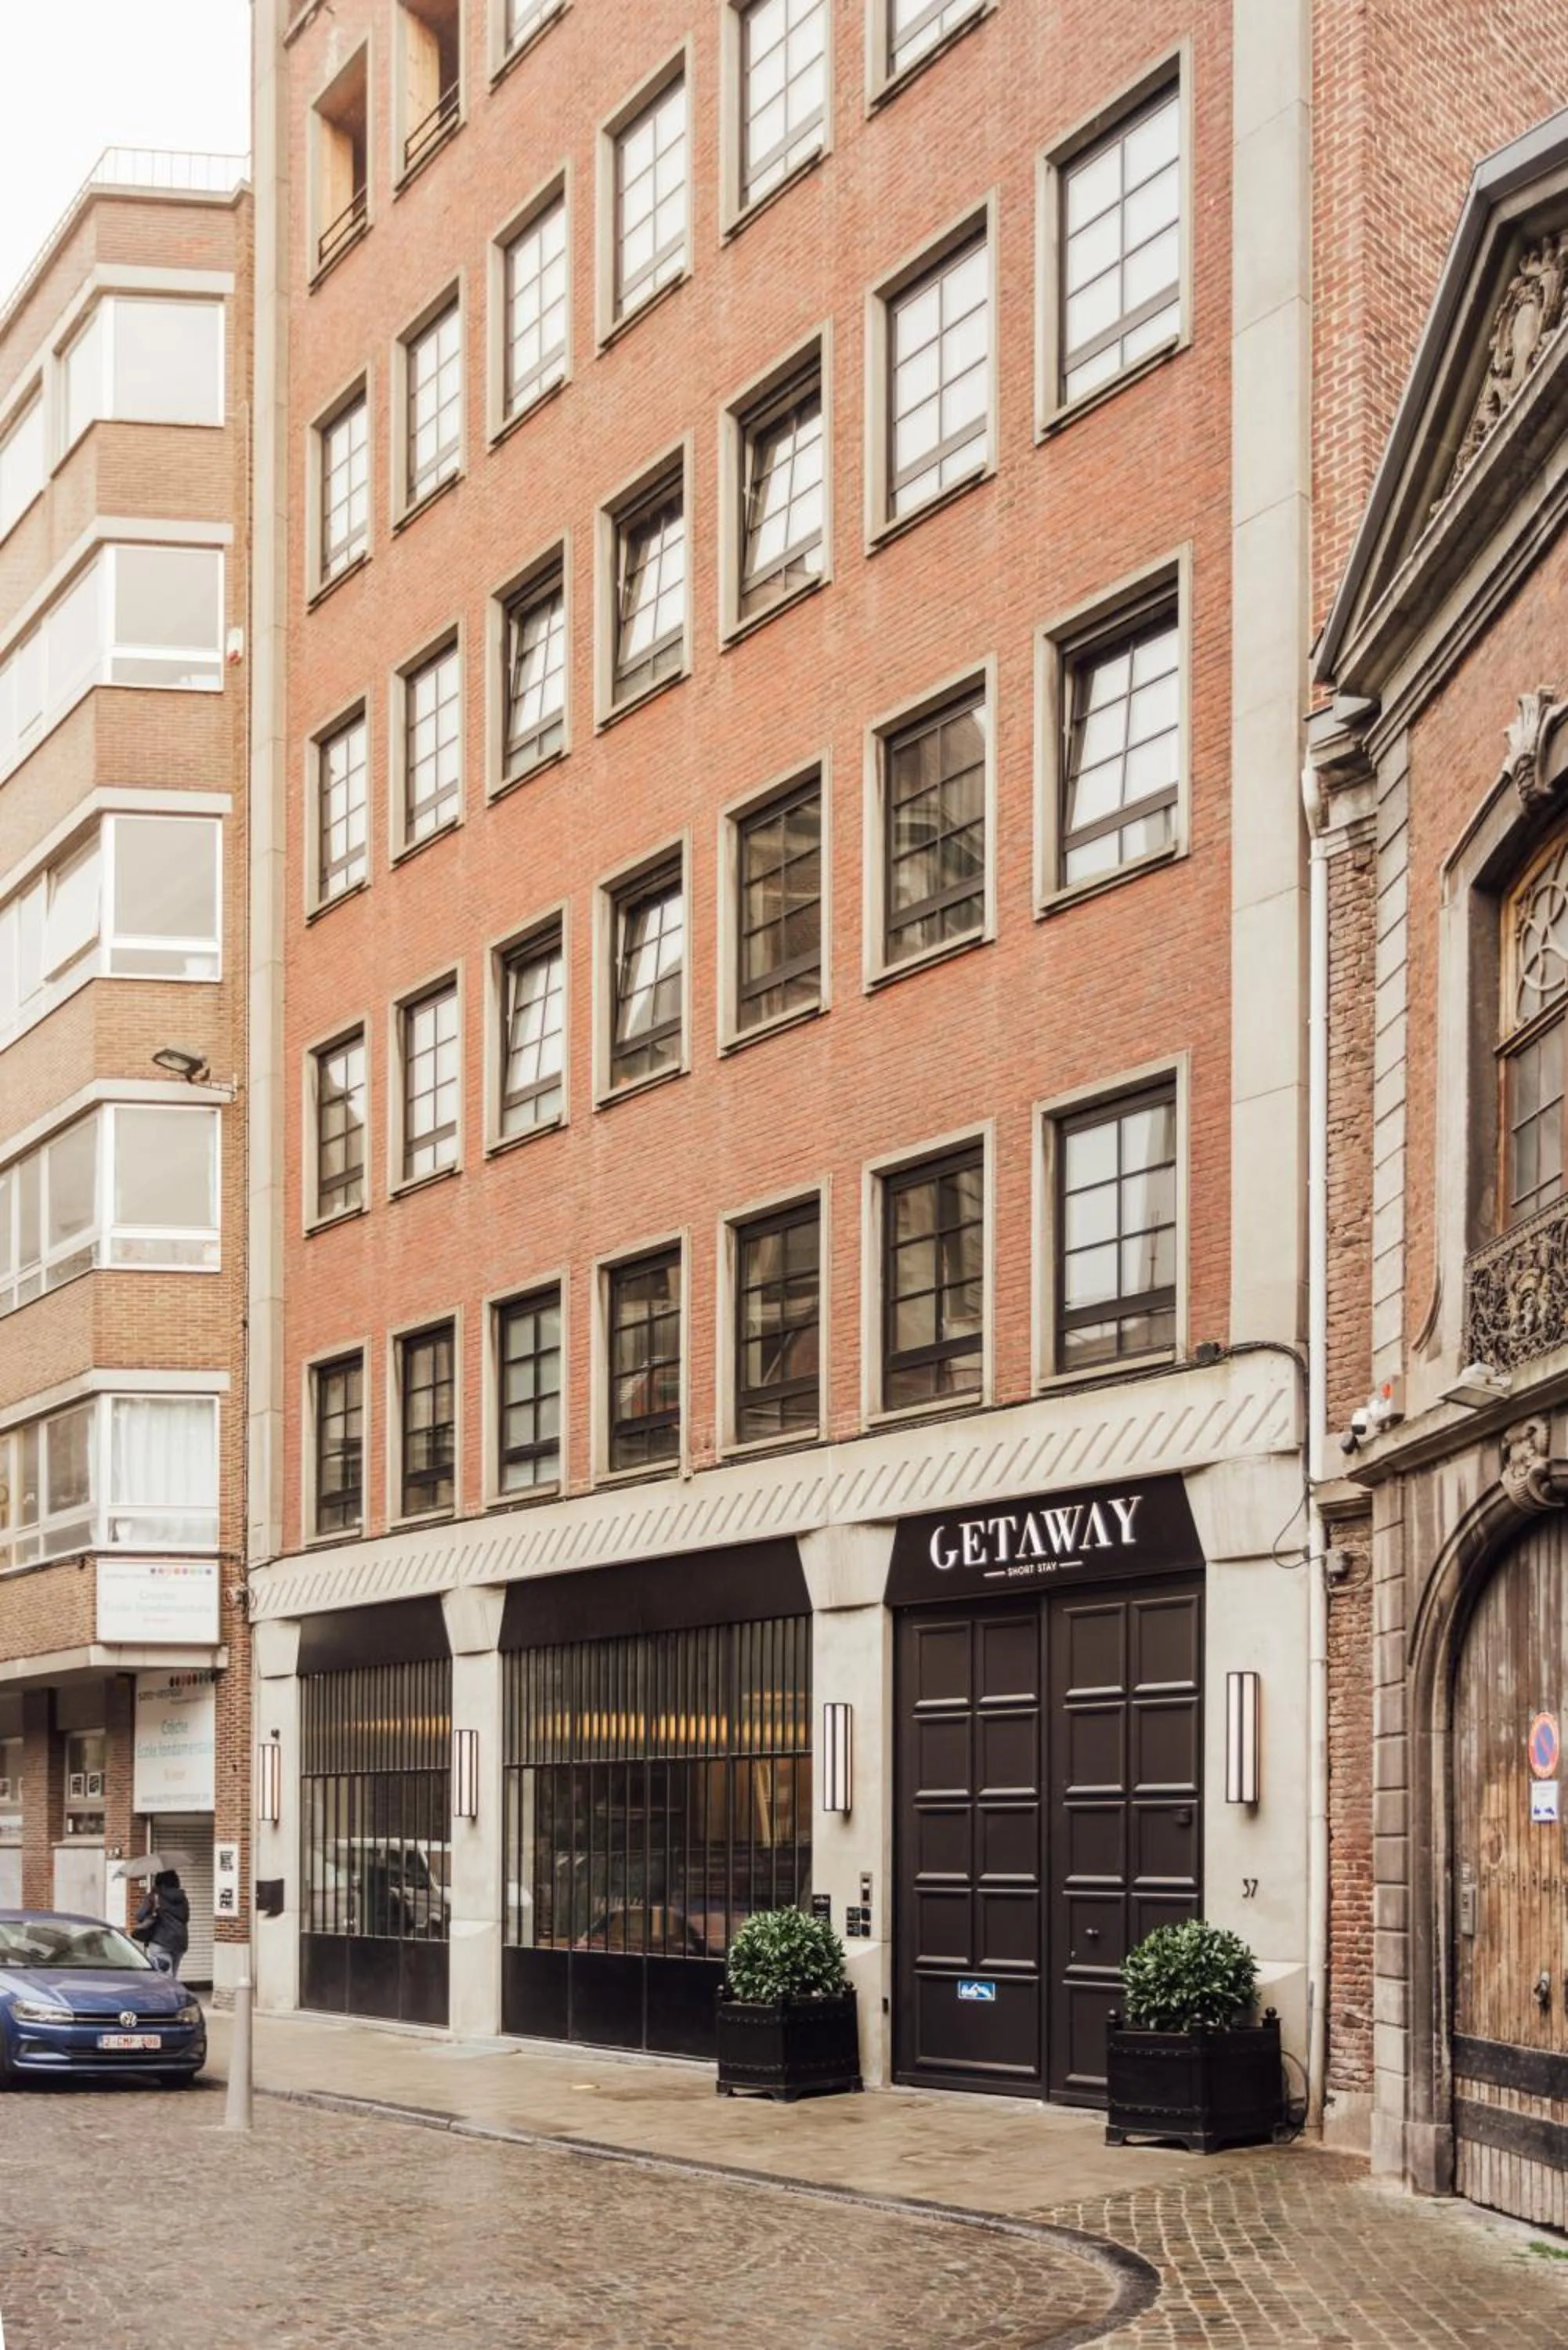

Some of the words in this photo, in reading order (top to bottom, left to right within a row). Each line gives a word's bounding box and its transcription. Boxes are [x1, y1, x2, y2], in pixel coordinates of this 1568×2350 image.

[930, 1495, 1143, 1570] GETAWAY
[1007, 1565, 1034, 1577] SHORT
[1037, 1562, 1057, 1572] STAY
